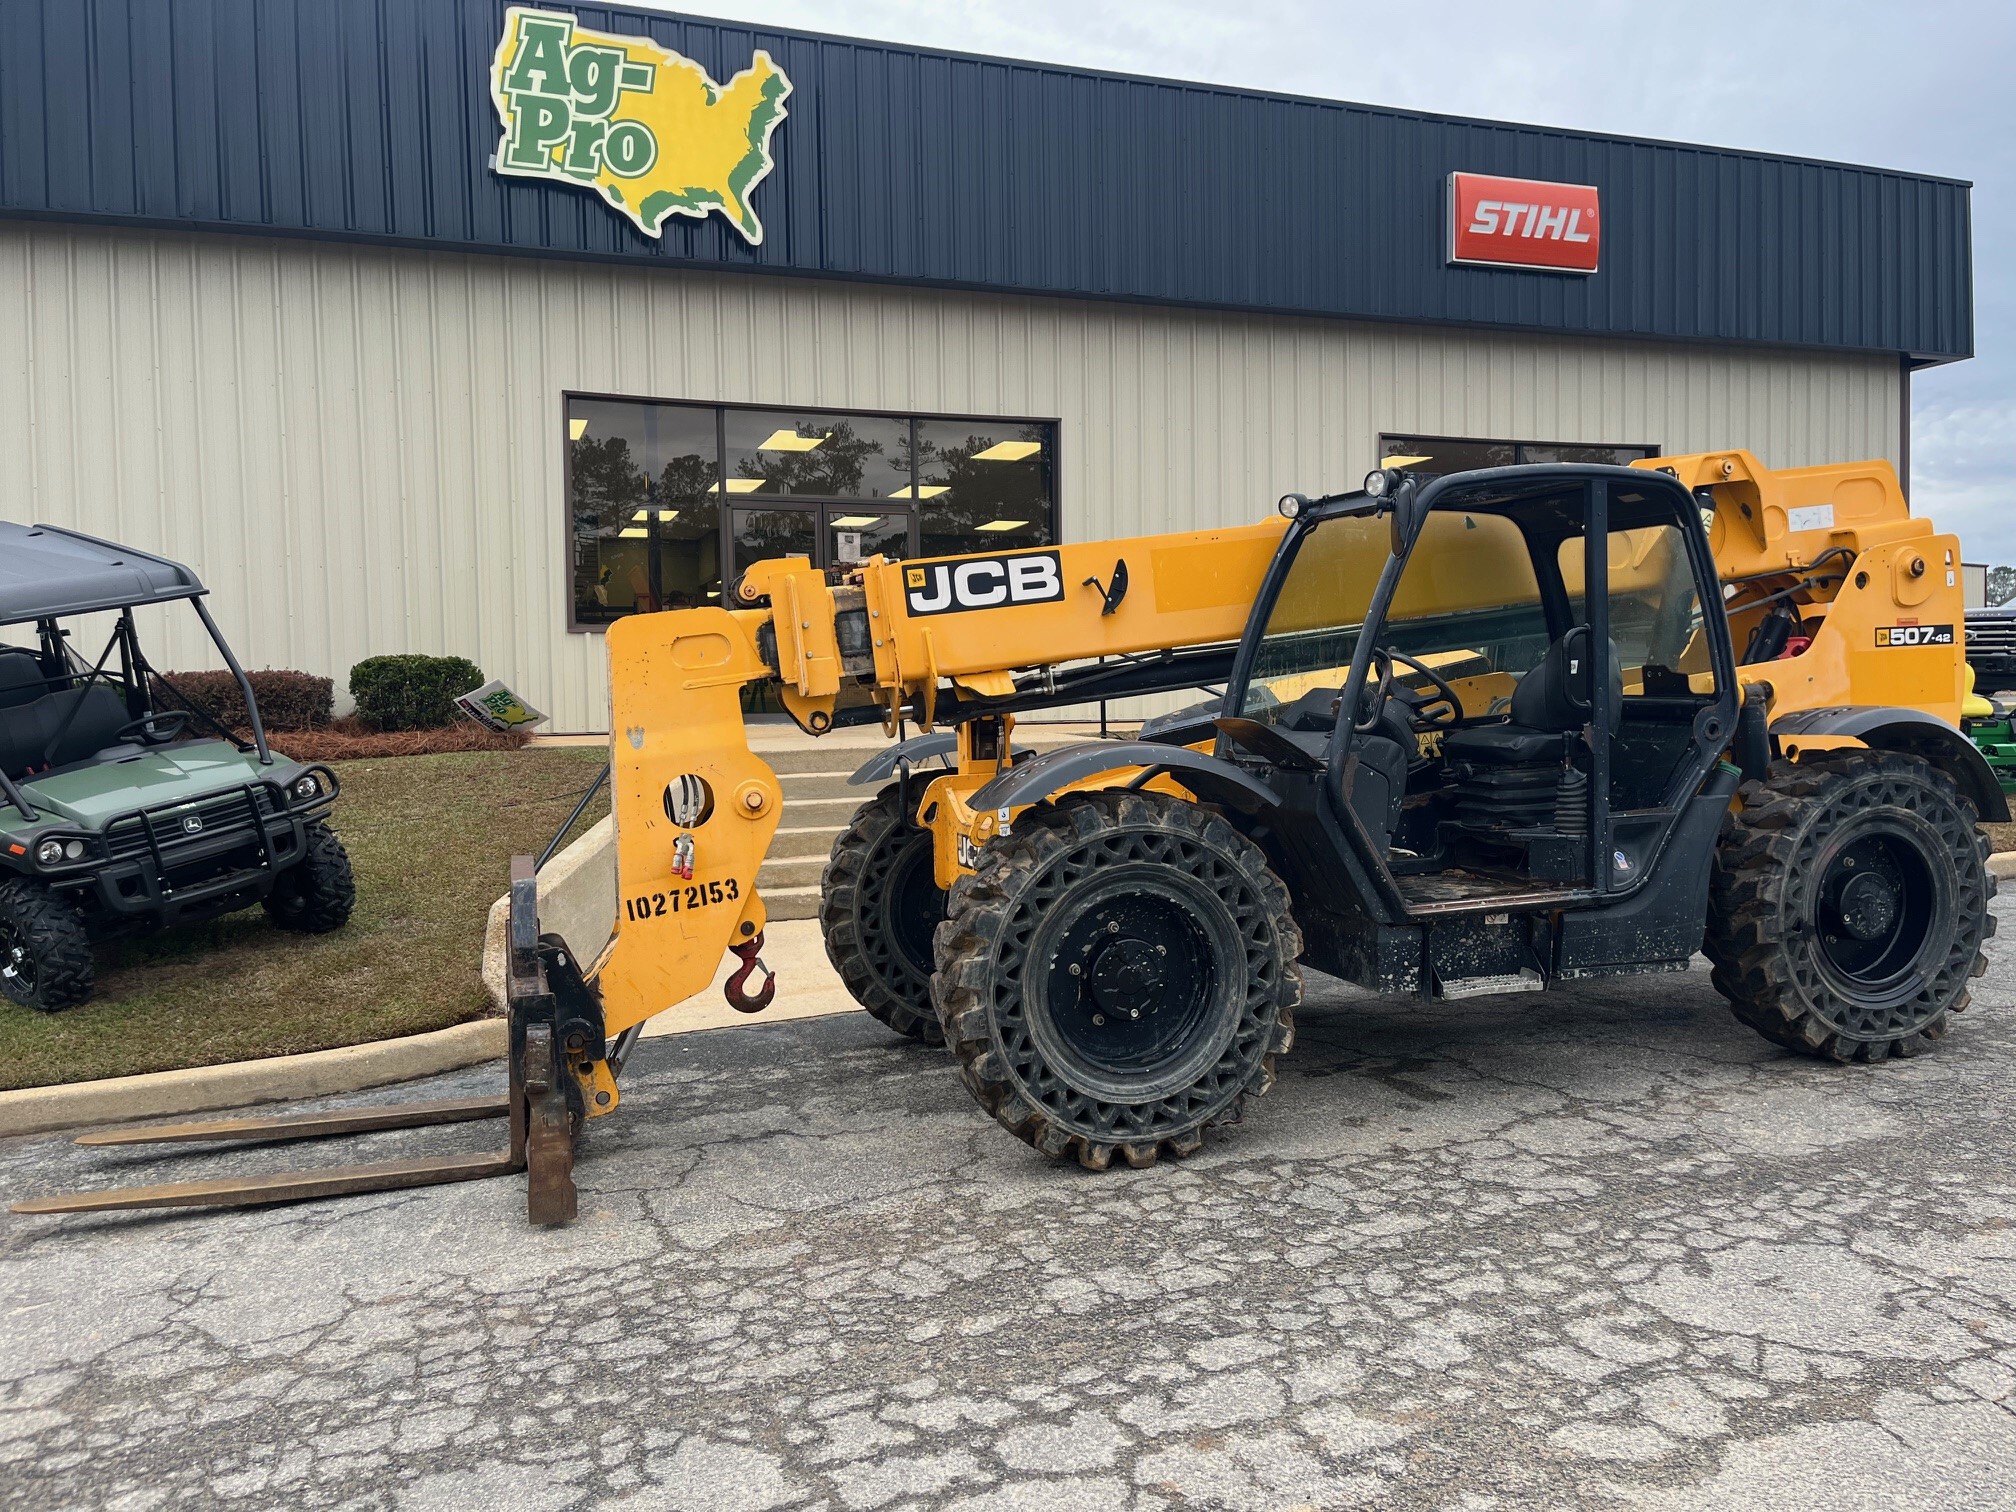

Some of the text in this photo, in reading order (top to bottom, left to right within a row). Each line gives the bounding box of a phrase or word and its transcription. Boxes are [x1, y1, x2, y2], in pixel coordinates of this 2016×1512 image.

[503, 15, 655, 117] Ag-
[504, 93, 657, 178] Pro
[1468, 200, 1590, 243] STIHL
[910, 556, 1060, 612] JCB
[1890, 627, 1951, 645] 507-42
[626, 878, 739, 921] 10272153
